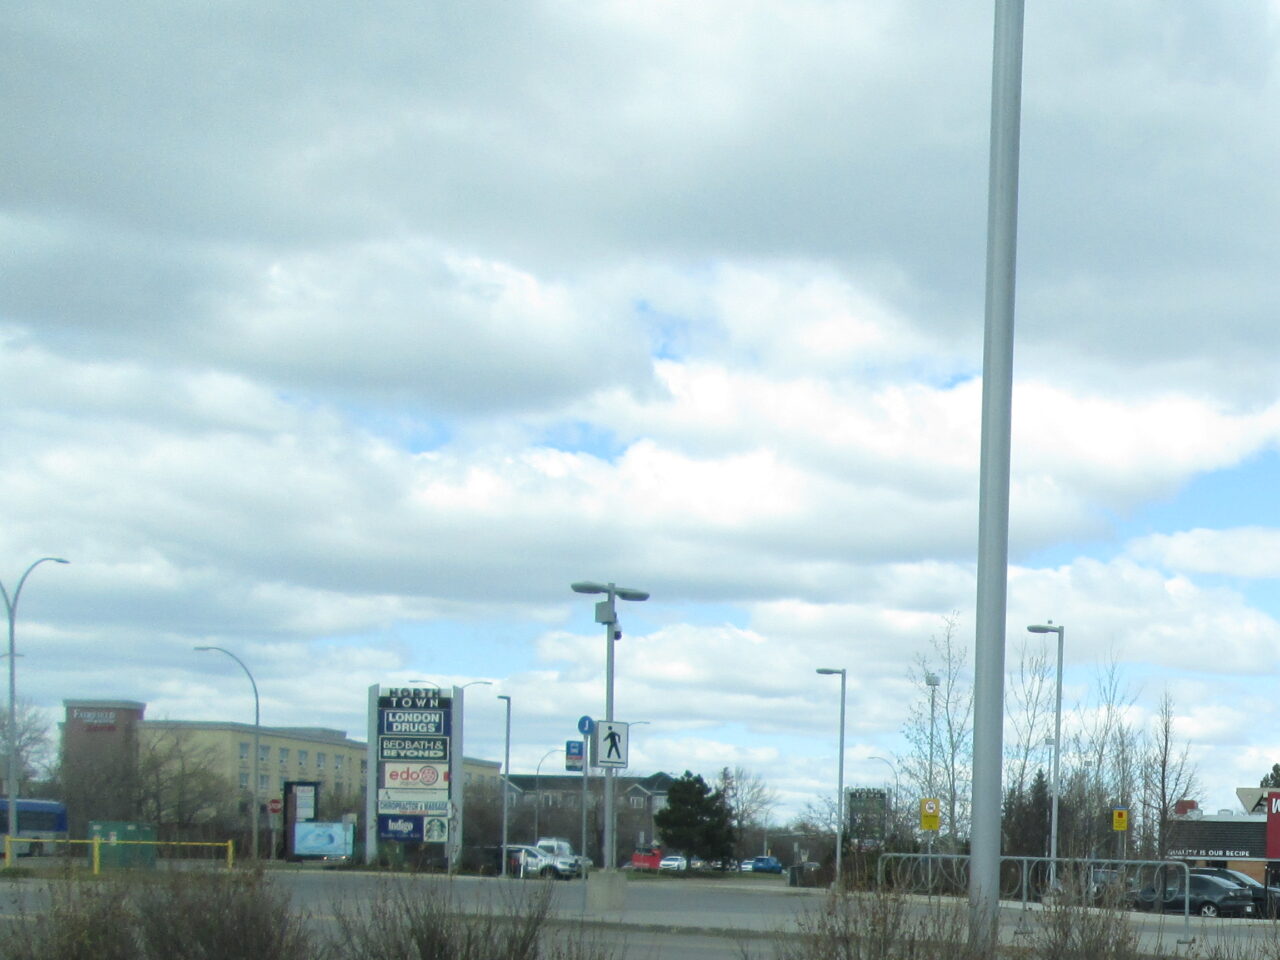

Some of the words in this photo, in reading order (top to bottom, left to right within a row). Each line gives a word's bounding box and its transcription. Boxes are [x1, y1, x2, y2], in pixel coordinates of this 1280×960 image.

[389, 687, 439, 697] NORTH
[391, 697, 439, 707] TOWN
[388, 712, 440, 722] LONDON
[392, 722, 436, 733] DRUGS
[383, 740, 404, 749] BED
[405, 740, 434, 750] BATH
[434, 740, 444, 750] &
[383, 749, 445, 758] BEYOND
[389, 767, 420, 781] edo
[388, 819, 414, 833] Indigo
[1168, 848, 1198, 856] QUALITY
